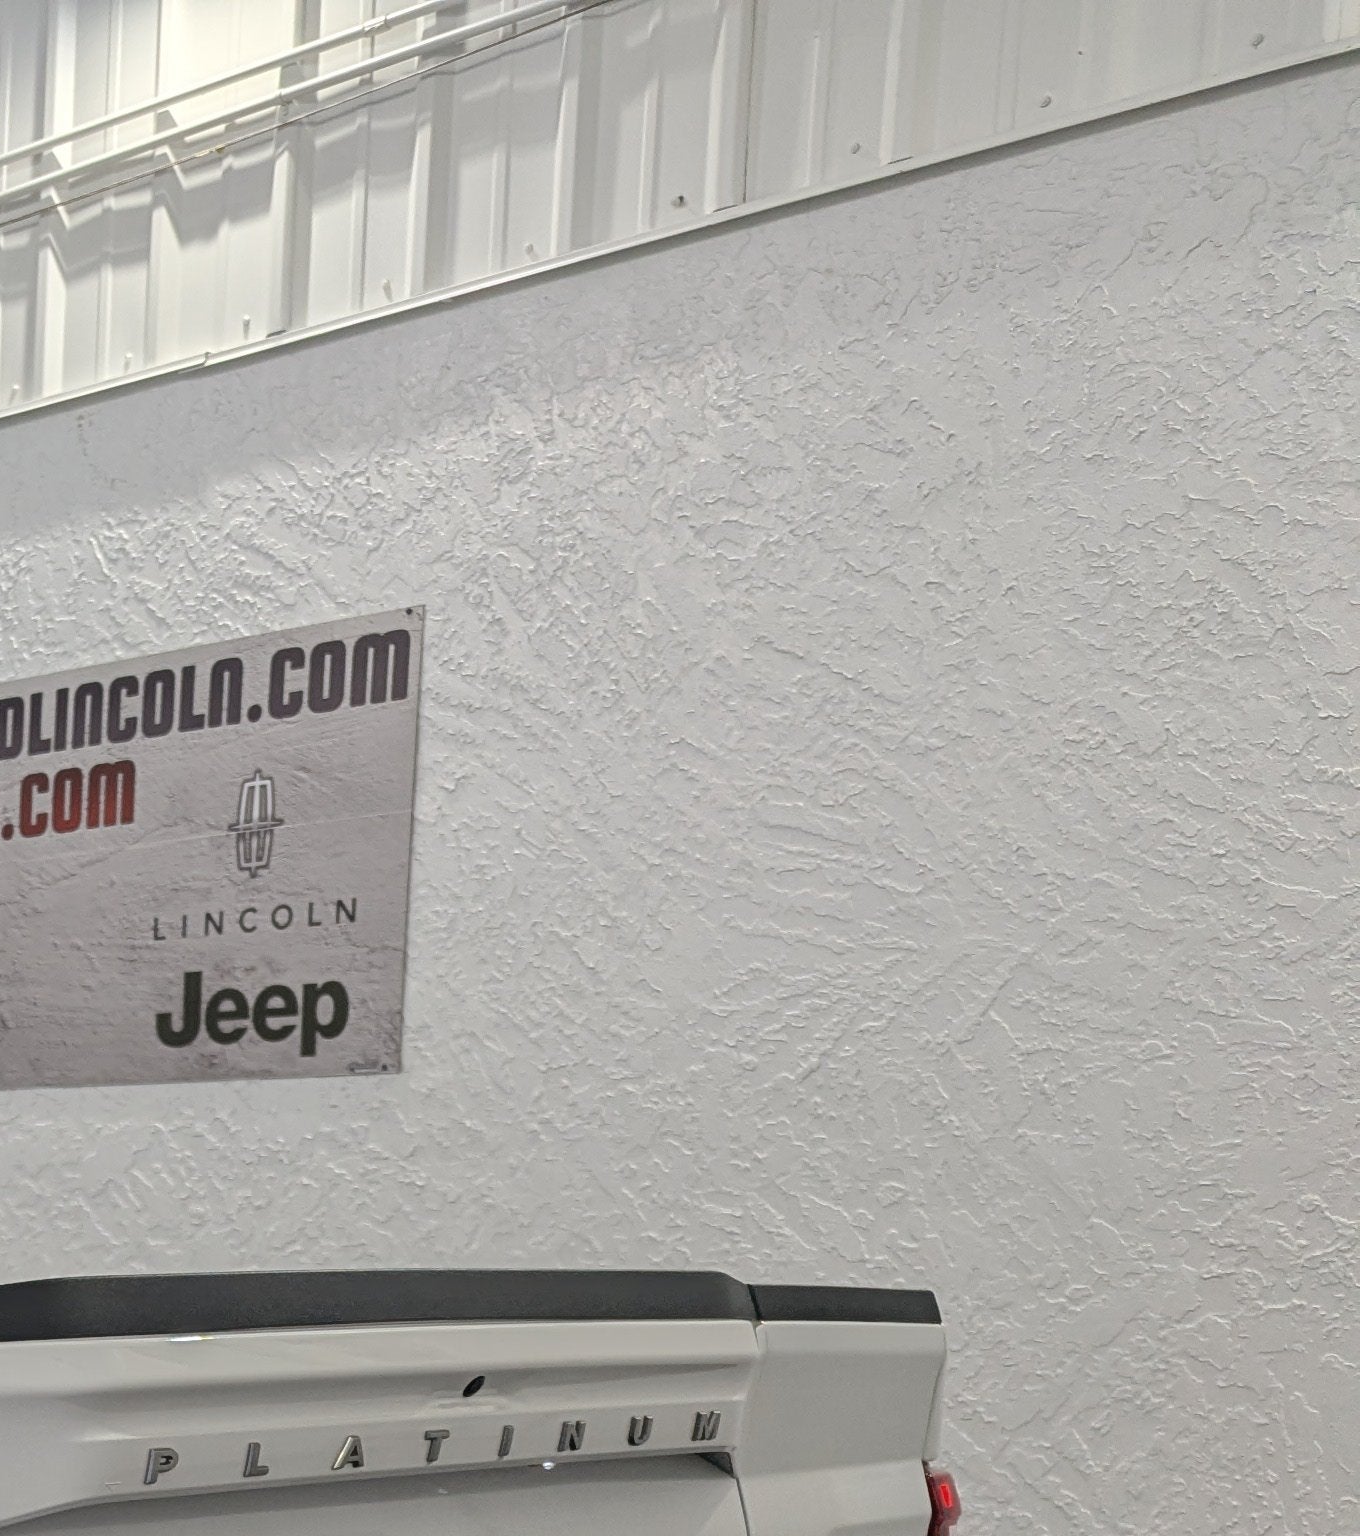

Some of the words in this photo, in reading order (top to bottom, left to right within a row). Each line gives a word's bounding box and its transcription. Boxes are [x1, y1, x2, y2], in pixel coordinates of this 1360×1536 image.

[152, 898, 358, 941] LINCOLN
[155, 971, 350, 1058] Jeep
[143, 1410, 722, 1485] PLATINUM
